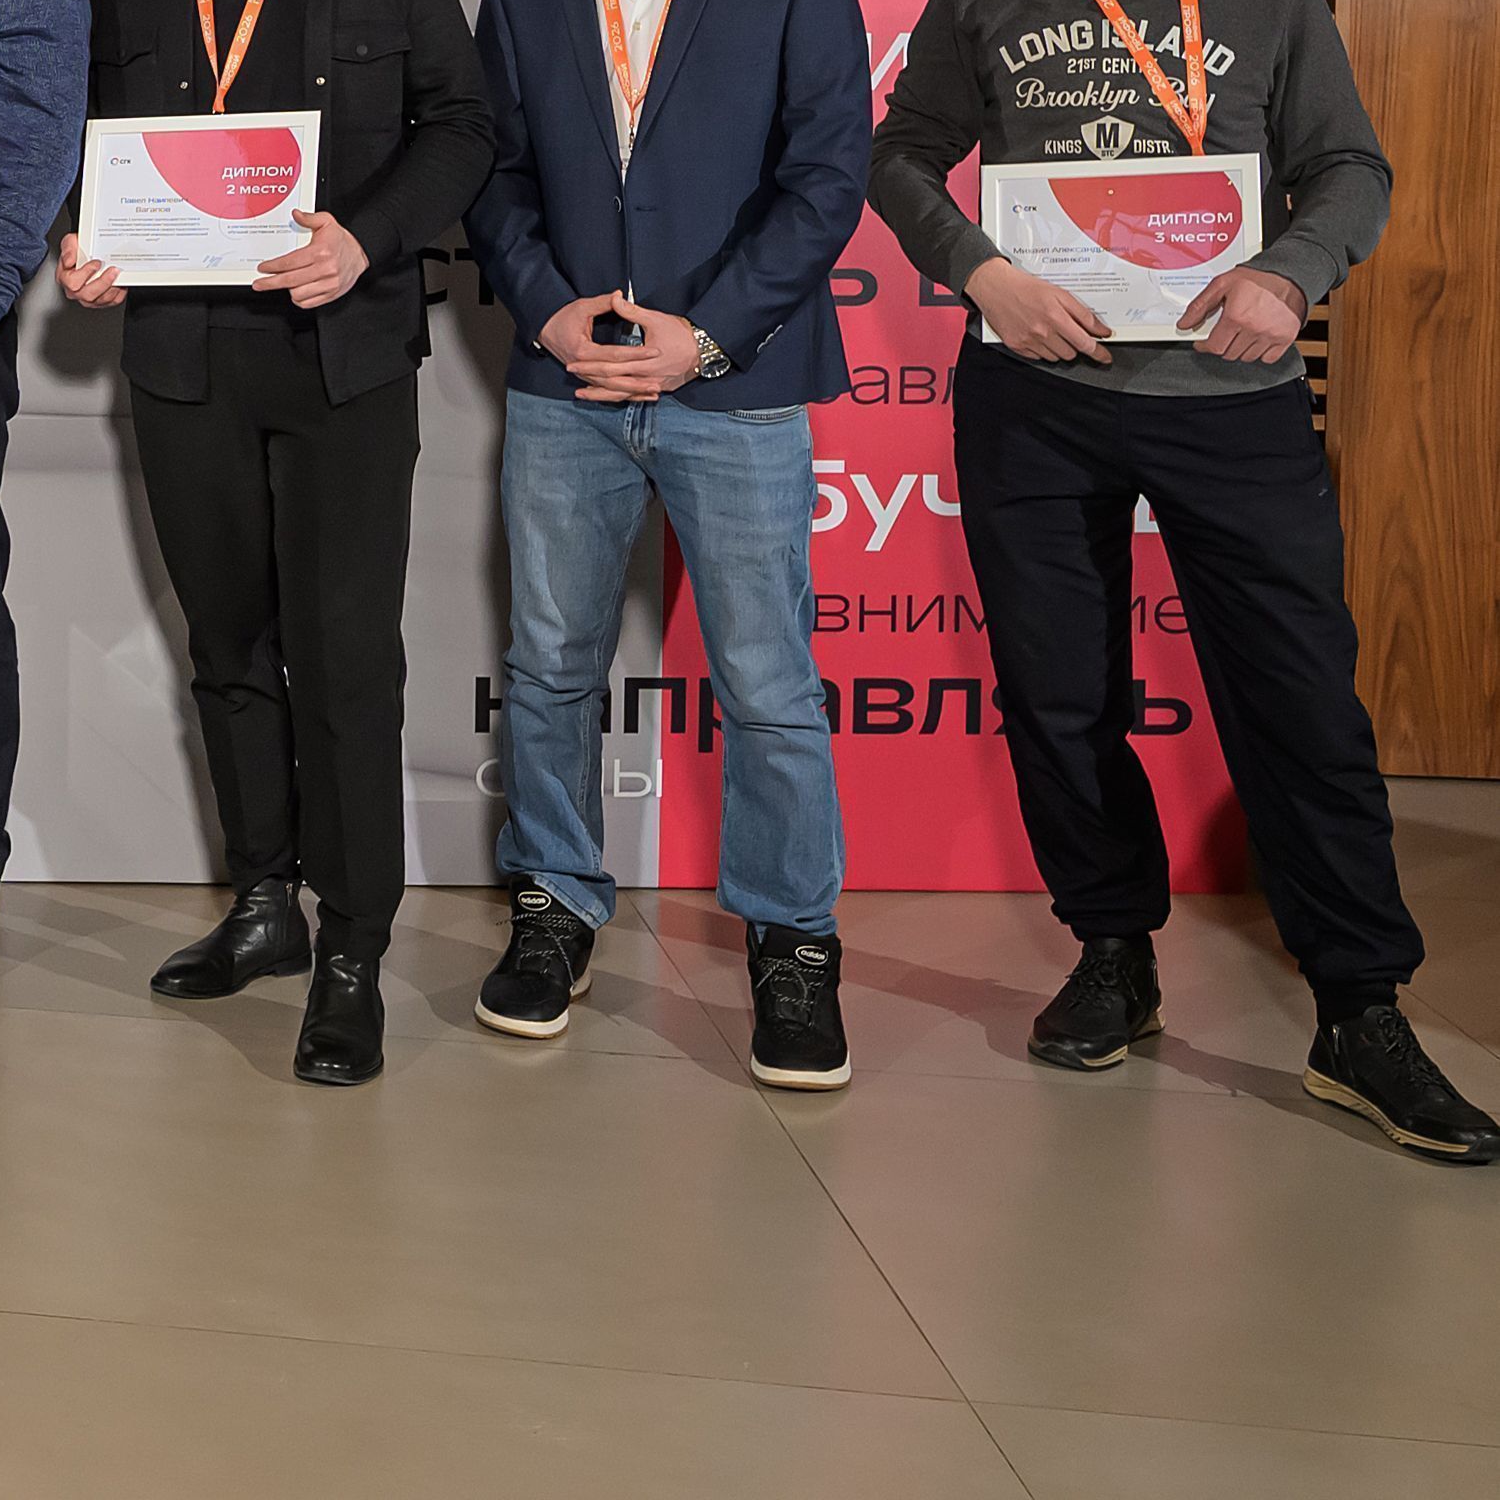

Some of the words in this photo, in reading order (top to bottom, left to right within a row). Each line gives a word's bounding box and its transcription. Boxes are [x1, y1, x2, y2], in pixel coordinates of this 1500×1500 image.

[202, 14, 211, 44] 2026
[236, 14, 253, 44] 2026
[611, 21, 623, 53] 2026
[1119, 16, 1144, 51] ПРОФИ
[1183, 5, 1193, 43] ПРОФИ
[999, 20, 1095, 74] LONG
[1067, 58, 1096, 74] 21ST
[1145, 60, 1167, 92] 2026
[1189, 54, 1200, 86] 2026
[1015, 77, 1139, 112] Brooklyn
[1045, 140, 1082, 154] KINGS
[1133, 139, 1174, 154] DISTR.
[1096, 123, 1119, 149] M
[222, 166, 293, 180] ДИПЛОМ
[120, 197, 147, 205] Павел
[226, 184, 236, 194] 2
[240, 184, 288, 194] место
[1148, 212, 1233, 227] ДИПЛОМ
[1154, 232, 1165, 242] 3
[1171, 232, 1229, 243] место
